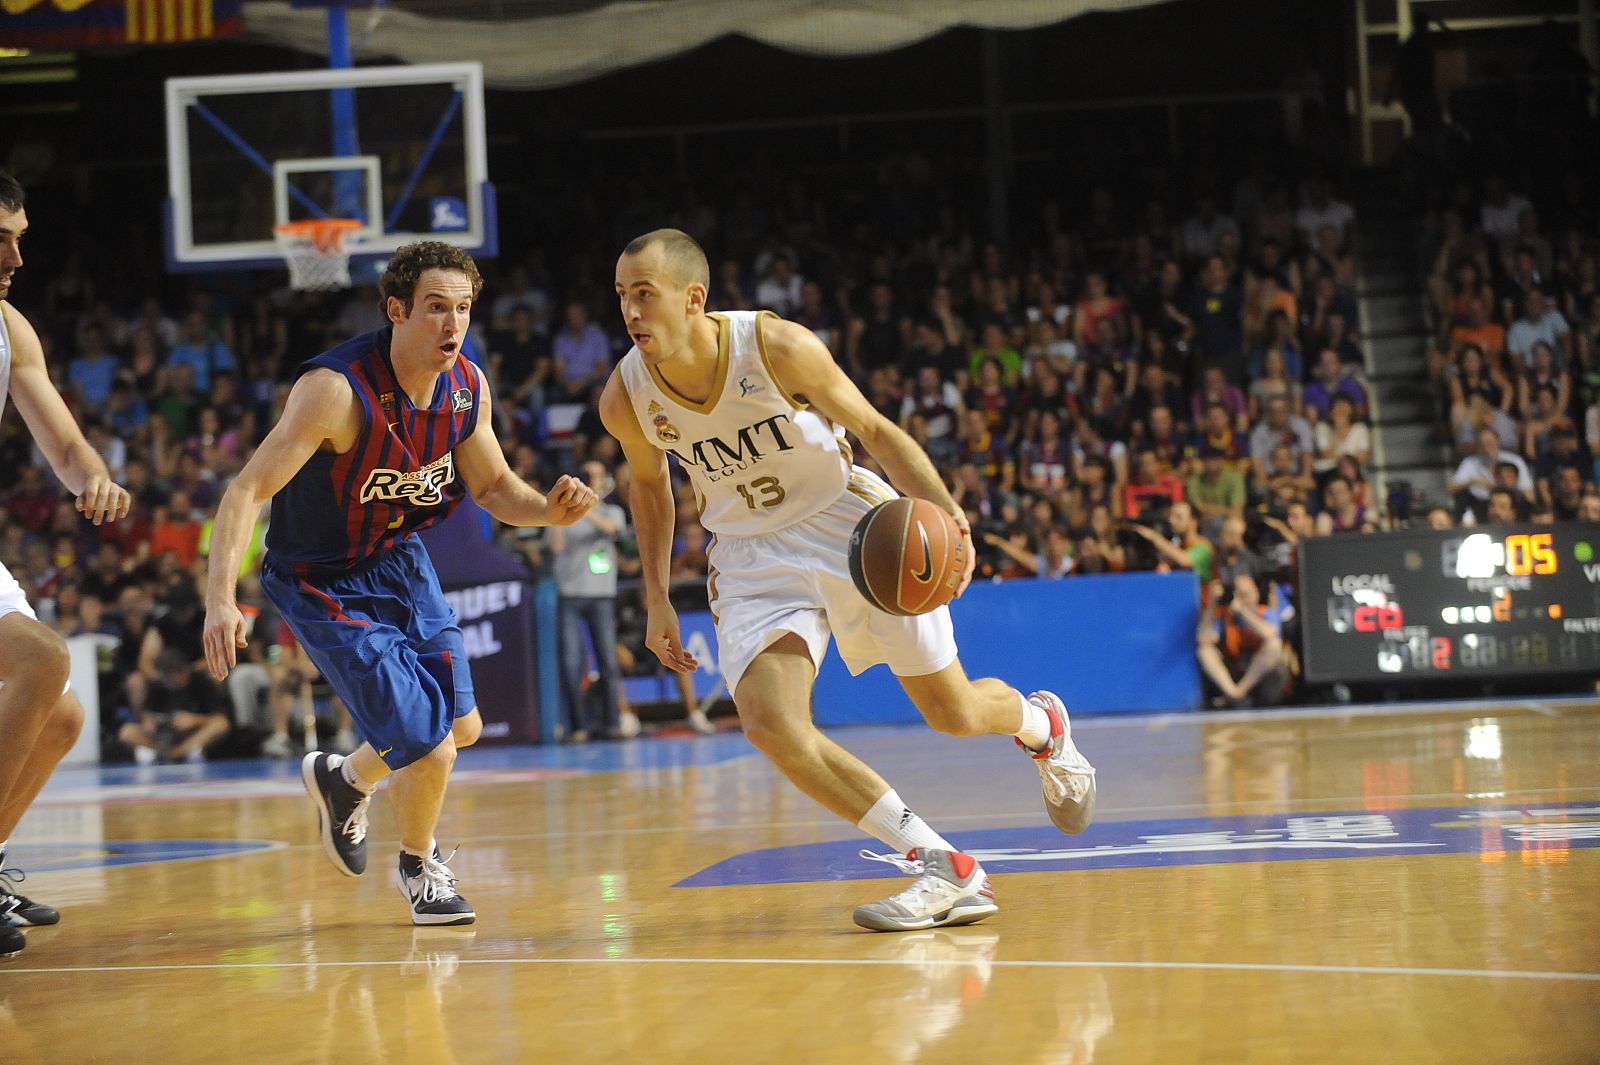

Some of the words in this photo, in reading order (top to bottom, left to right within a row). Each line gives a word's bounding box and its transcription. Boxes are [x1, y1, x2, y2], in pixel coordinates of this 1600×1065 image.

[665, 414, 794, 473] MMT
[736, 476, 786, 510] 13
[1505, 533, 1558, 576] 05
